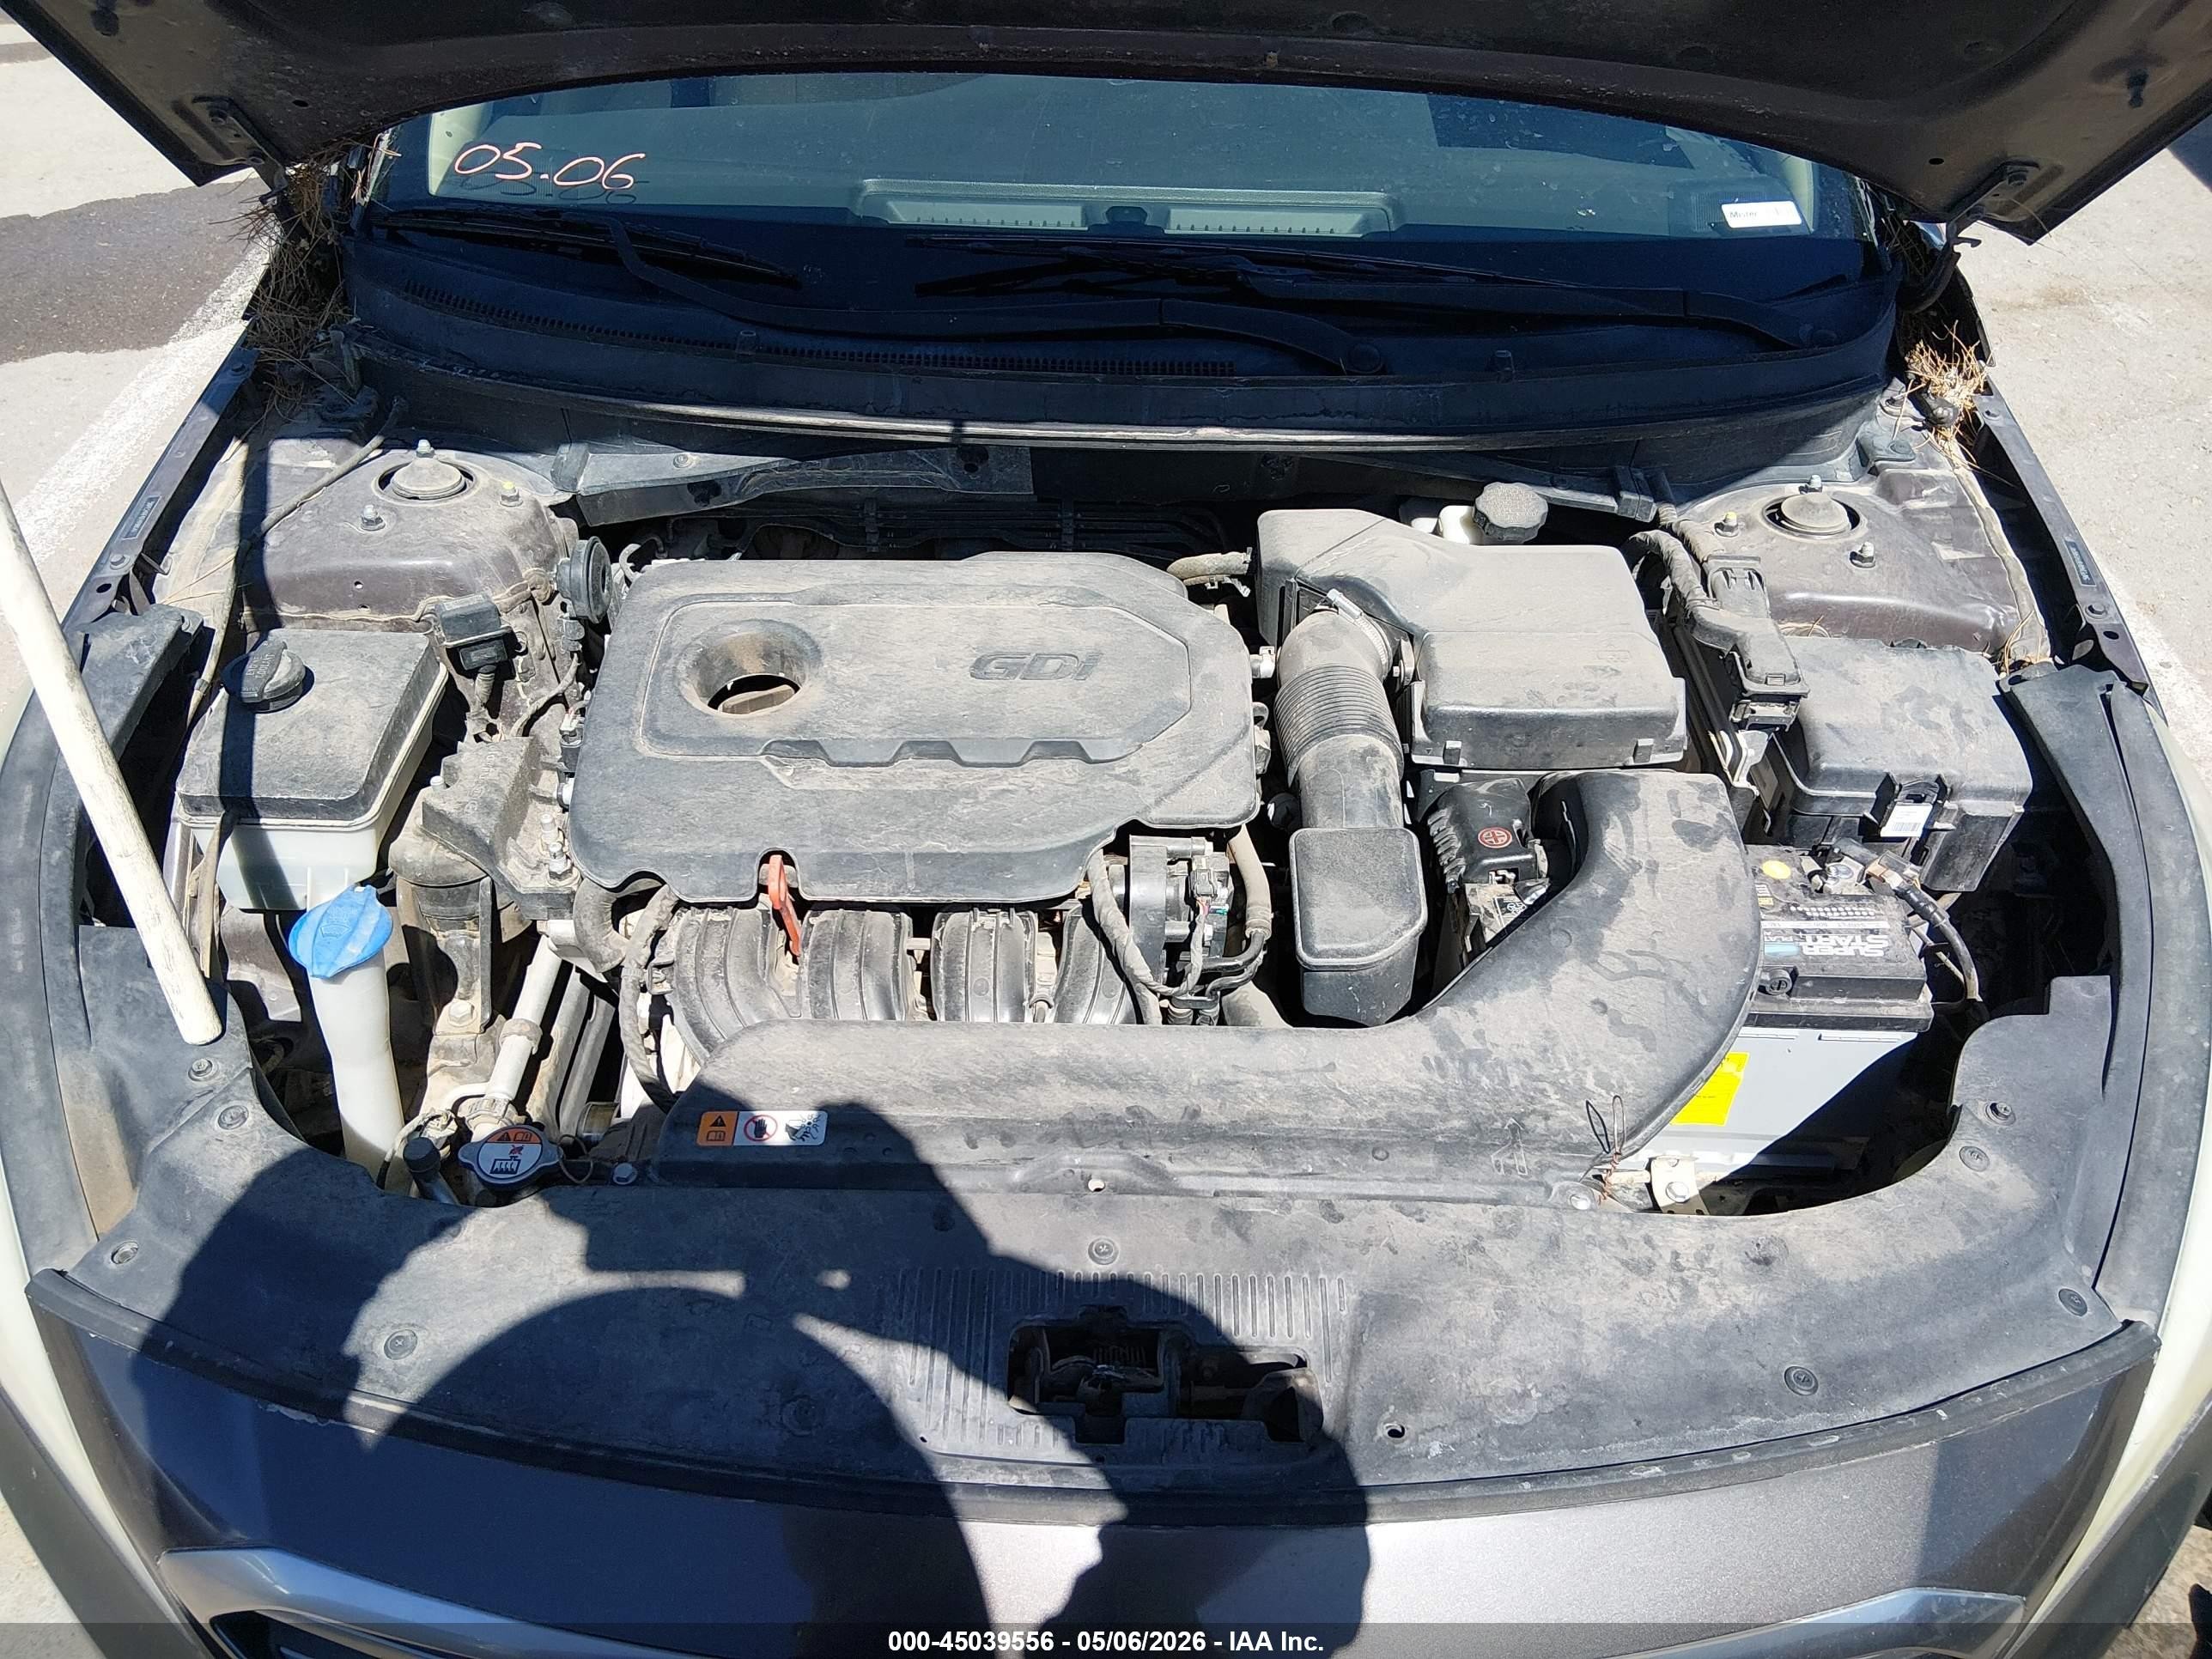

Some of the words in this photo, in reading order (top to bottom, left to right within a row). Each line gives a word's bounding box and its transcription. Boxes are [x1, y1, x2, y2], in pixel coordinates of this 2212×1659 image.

[454, 142, 647, 190] 05.06
[246, 655, 263, 677] ENGINE
[255, 653, 276, 679] COOLANT
[1798, 934, 1889, 947] START
[1802, 945, 1886, 957] SUPER
